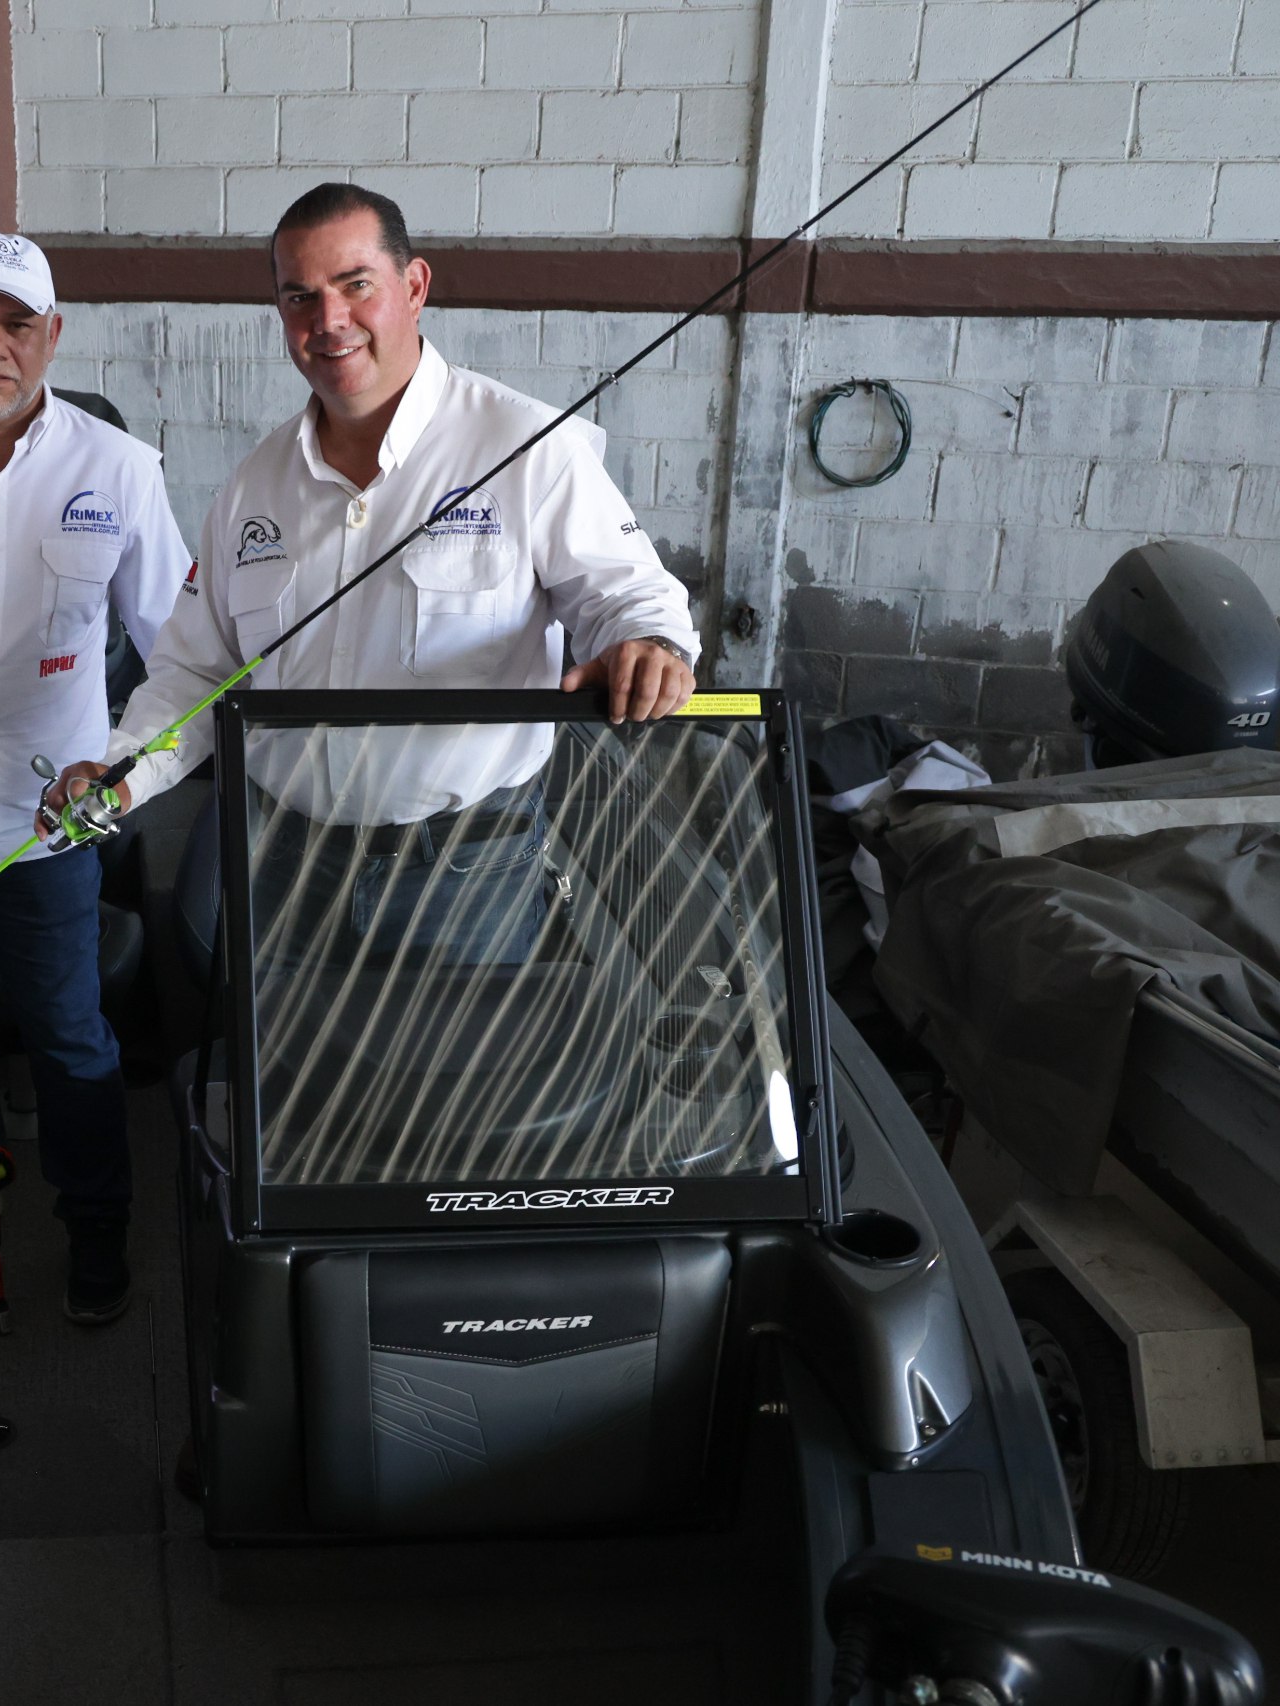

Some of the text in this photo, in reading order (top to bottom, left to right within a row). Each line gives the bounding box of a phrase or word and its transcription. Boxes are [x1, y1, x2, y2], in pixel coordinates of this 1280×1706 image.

[1227, 712, 1271, 728] 40
[426, 1187, 675, 1212] TRACKER
[441, 1315, 594, 1334] TRACKER
[960, 1550, 1112, 1589] MINN KOTA
